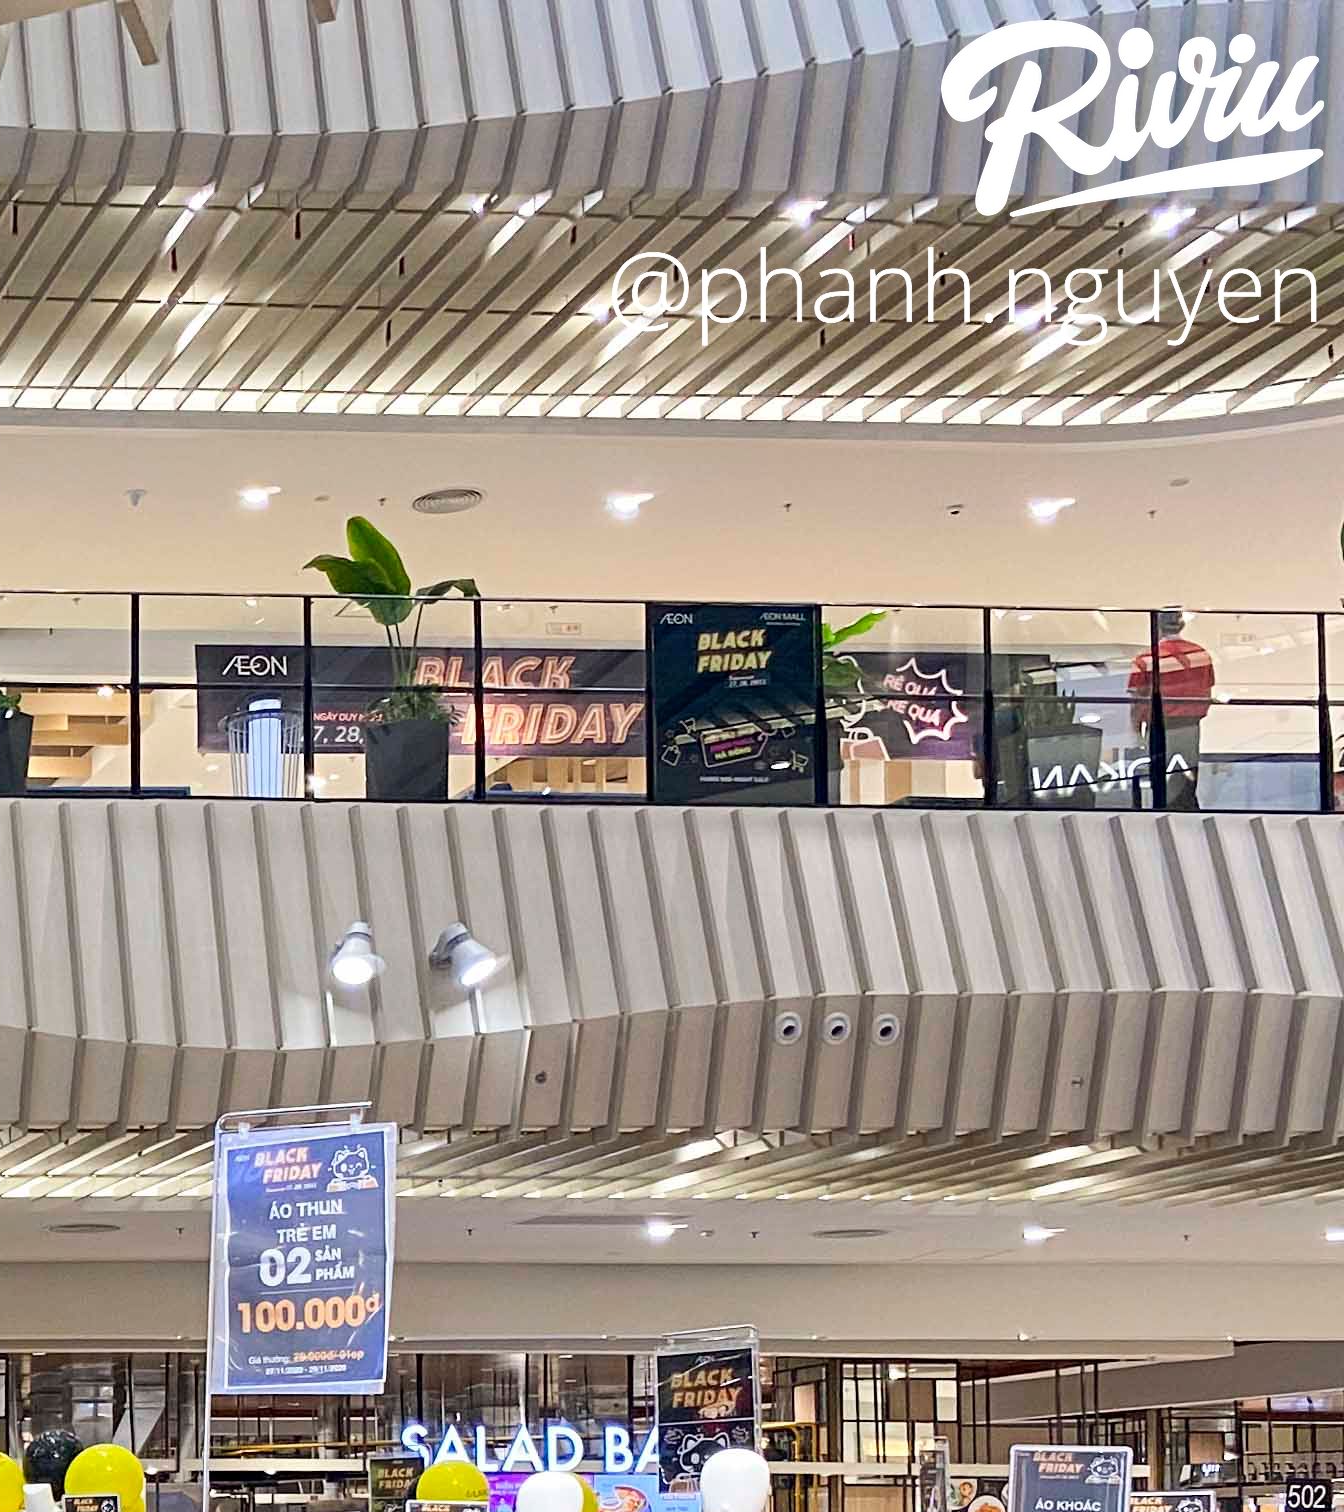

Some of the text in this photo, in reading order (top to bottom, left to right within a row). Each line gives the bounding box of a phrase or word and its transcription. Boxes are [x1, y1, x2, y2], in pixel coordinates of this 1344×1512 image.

[696, 629, 766, 652] BLACK
[696, 651, 772, 674] FRIDAY
[415, 655, 576, 697] BLACK
[461, 703, 646, 746] FRIDAY
[254, 1147, 309, 1168] BLACK
[263, 1162, 323, 1184] FRIDAY
[269, 1199, 343, 1220] ÁO THUN
[311, 1223, 337, 1242] EM
[259, 1246, 312, 1287] 02
[671, 1367, 734, 1389] BLACK
[671, 1387, 743, 1409] FRIDAY
[400, 1423, 585, 1473] SALAD
[1033, 1452, 1073, 1463] BLACK
[377, 1466, 414, 1478] BLACK
[1038, 1463, 1084, 1474] FRIDAY
[378, 1479, 417, 1489] FRIDA
[1035, 1497, 1102, 1512] ÁO KHOÁC
[1287, 1484, 1327, 1510] 502
